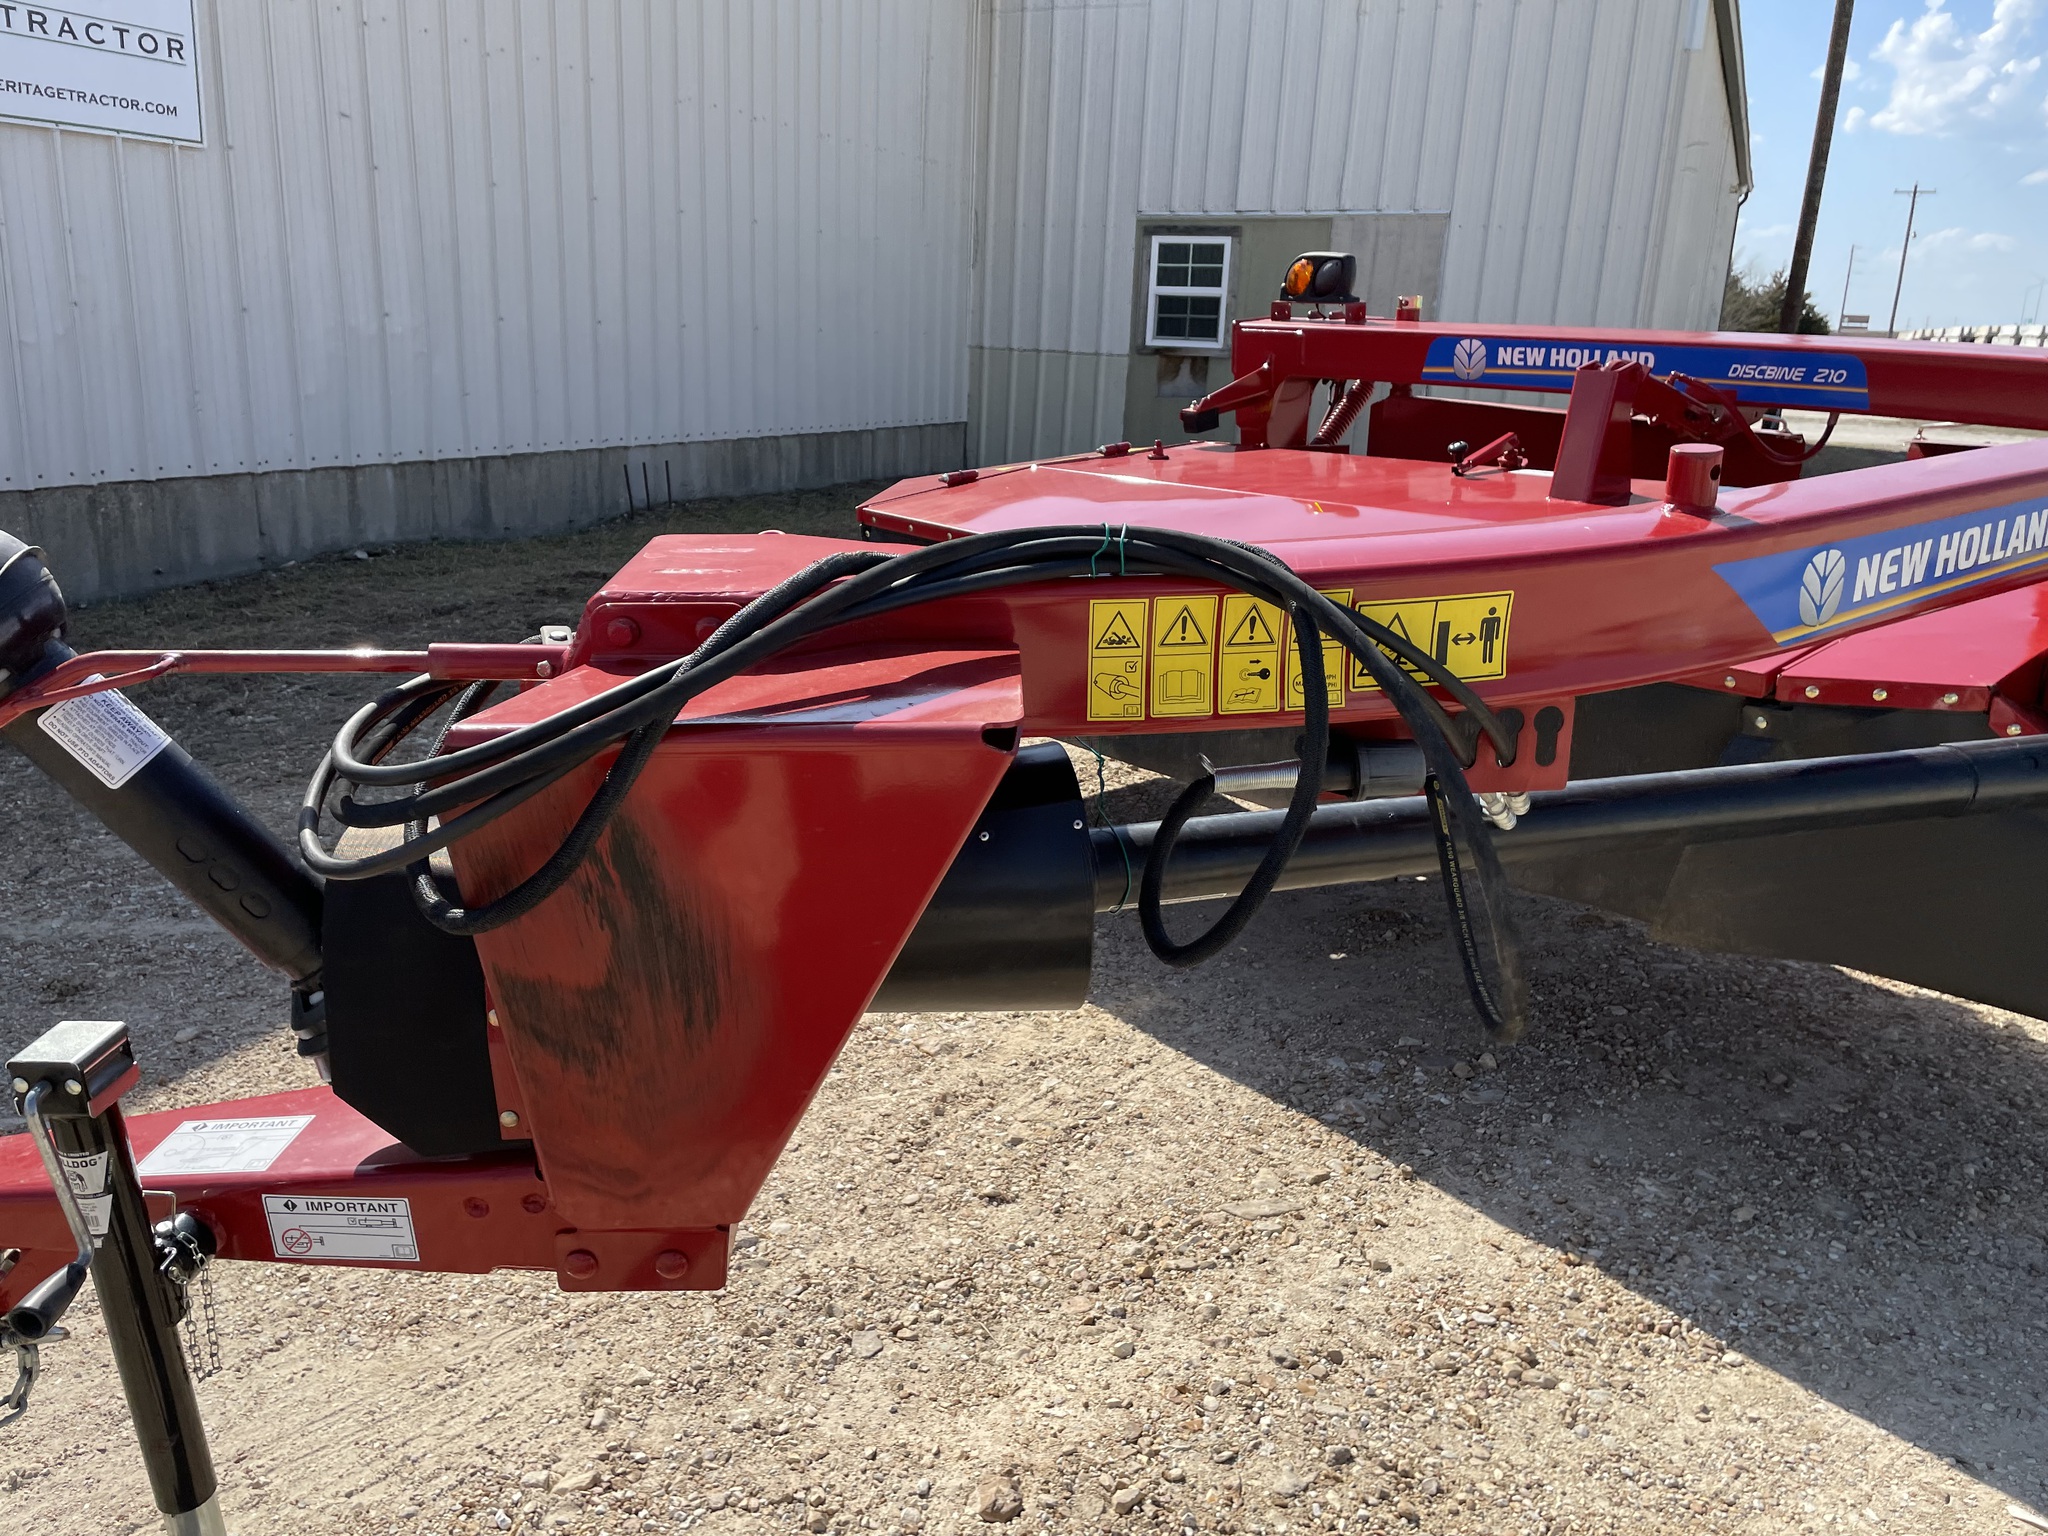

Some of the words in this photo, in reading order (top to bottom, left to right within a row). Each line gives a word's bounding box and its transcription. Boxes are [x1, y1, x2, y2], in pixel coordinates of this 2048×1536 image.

[0, 4, 185, 61] TRACTOR
[1497, 346, 1546, 366] NEW
[1727, 363, 1806, 381] DISCBINE
[1812, 368, 1847, 383] 210
[1852, 538, 1934, 603] NEW
[1934, 508, 2048, 578] HOLLAN
[92, 698, 104, 709] NOT
[102, 707, 127, 728] OPERATE
[100, 698, 121, 717] KEEP
[119, 715, 143, 736] AWAY!
[47, 720, 58, 729] DO
[55, 727, 68, 739] NOT
[66, 737, 79, 748] USE
[77, 746, 89, 757] PTO
[87, 755, 116, 780] ADAPTORS
[1449, 860, 1463, 908] WEARGUARD
[211, 1119, 299, 1131] IMPORTANT
[306, 1201, 398, 1213] IMPORTANT
